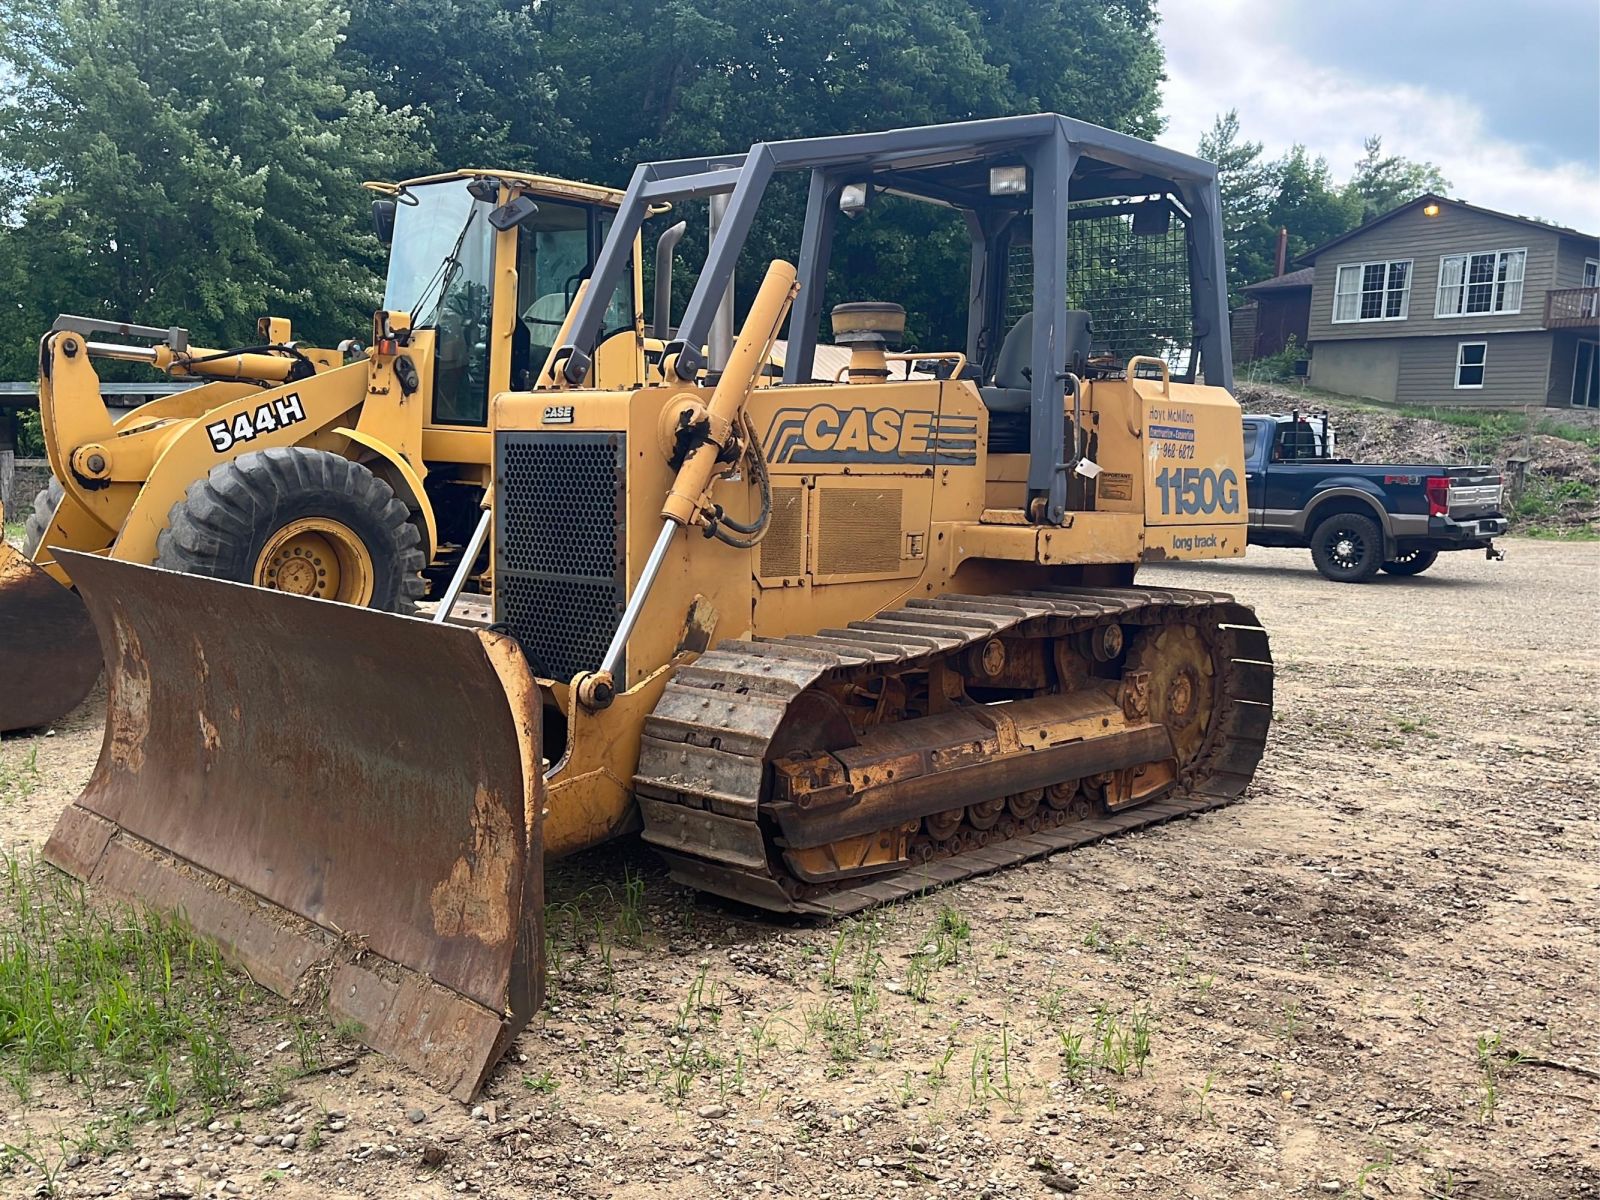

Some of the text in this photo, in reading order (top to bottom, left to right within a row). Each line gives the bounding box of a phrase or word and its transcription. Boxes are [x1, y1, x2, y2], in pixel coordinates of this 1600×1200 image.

[206, 392, 306, 453] 544H
[544, 406, 573, 418] CASE
[802, 404, 935, 453] CASE
[1156, 467, 1239, 515] 1150G
[1173, 533, 1217, 551] long track
